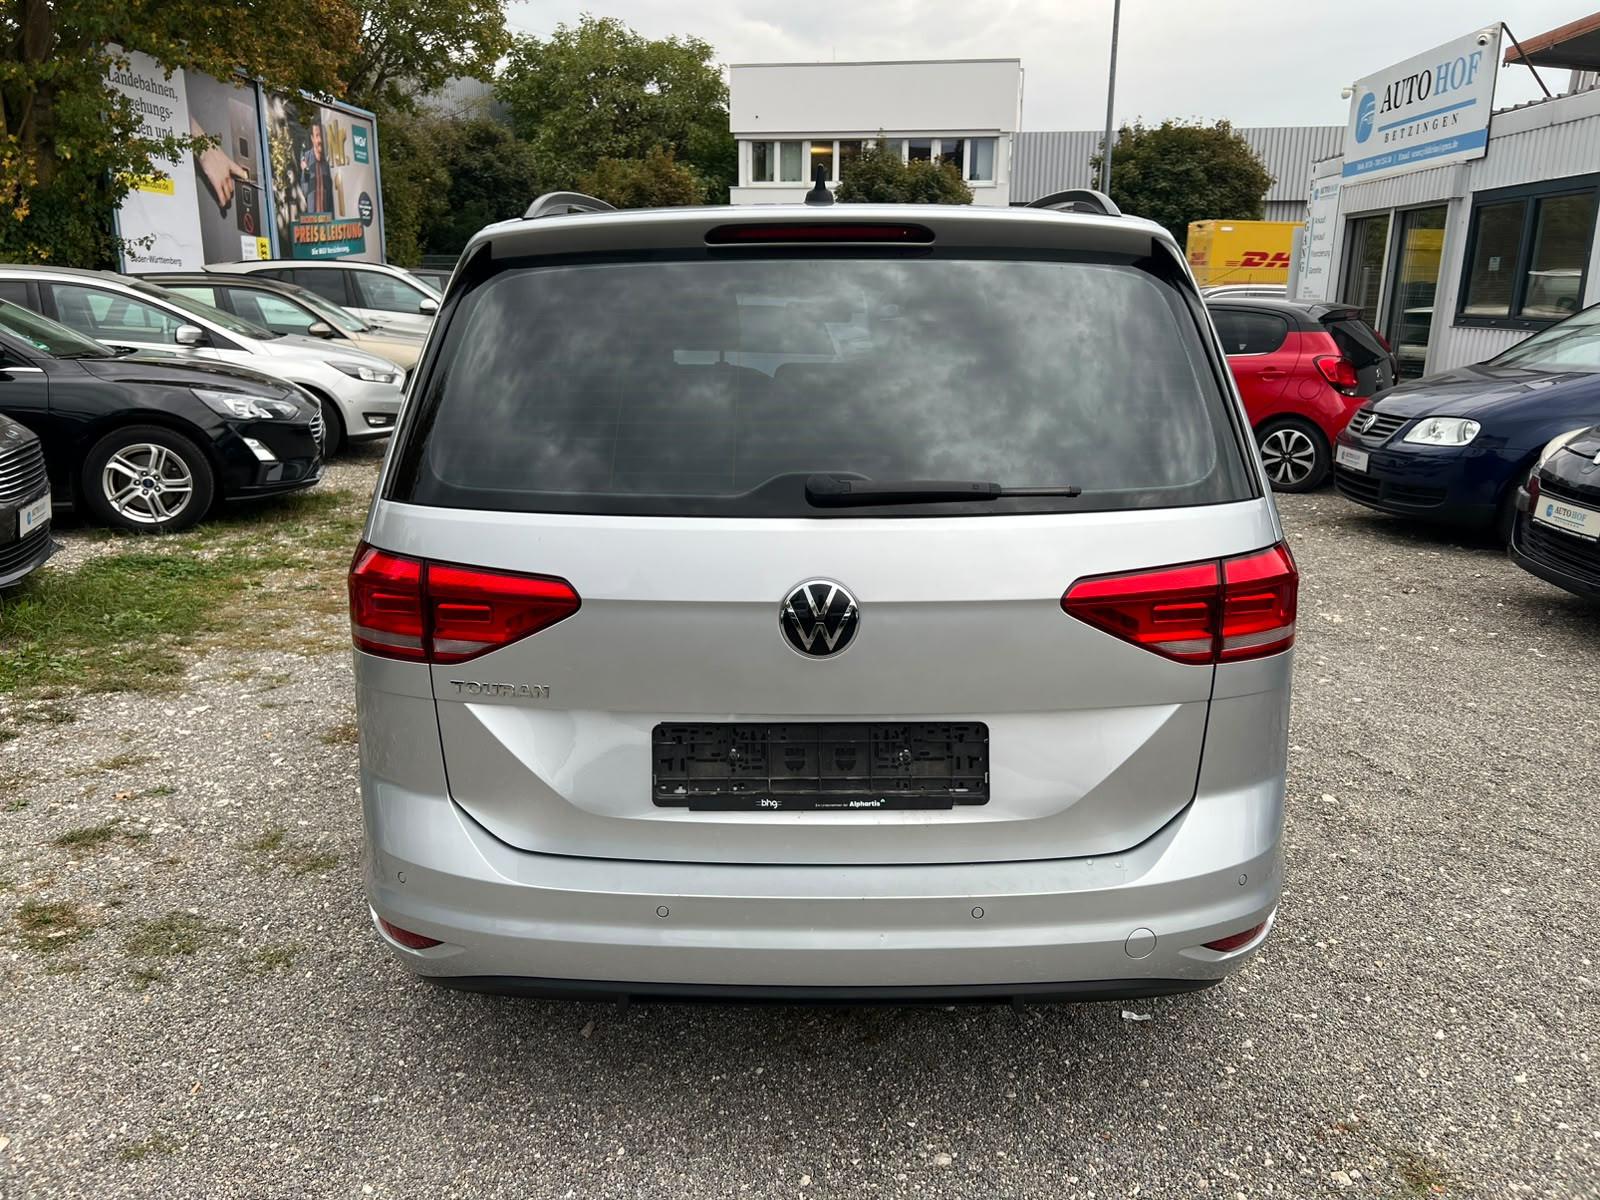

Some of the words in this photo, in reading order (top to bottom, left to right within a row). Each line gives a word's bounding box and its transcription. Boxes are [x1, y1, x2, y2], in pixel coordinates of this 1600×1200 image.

[108, 71, 178, 102] Landebahnen,
[1379, 69, 1432, 114] AUTO
[1433, 50, 1482, 97] HOF
[1384, 112, 1460, 144] BETZINGEN
[294, 224, 319, 243] PREIS
[326, 222, 363, 241] LEISTUNG
[1240, 251, 1290, 268] DH
[450, 680, 550, 699] TOURAN
[761, 799, 778, 809] bhg
